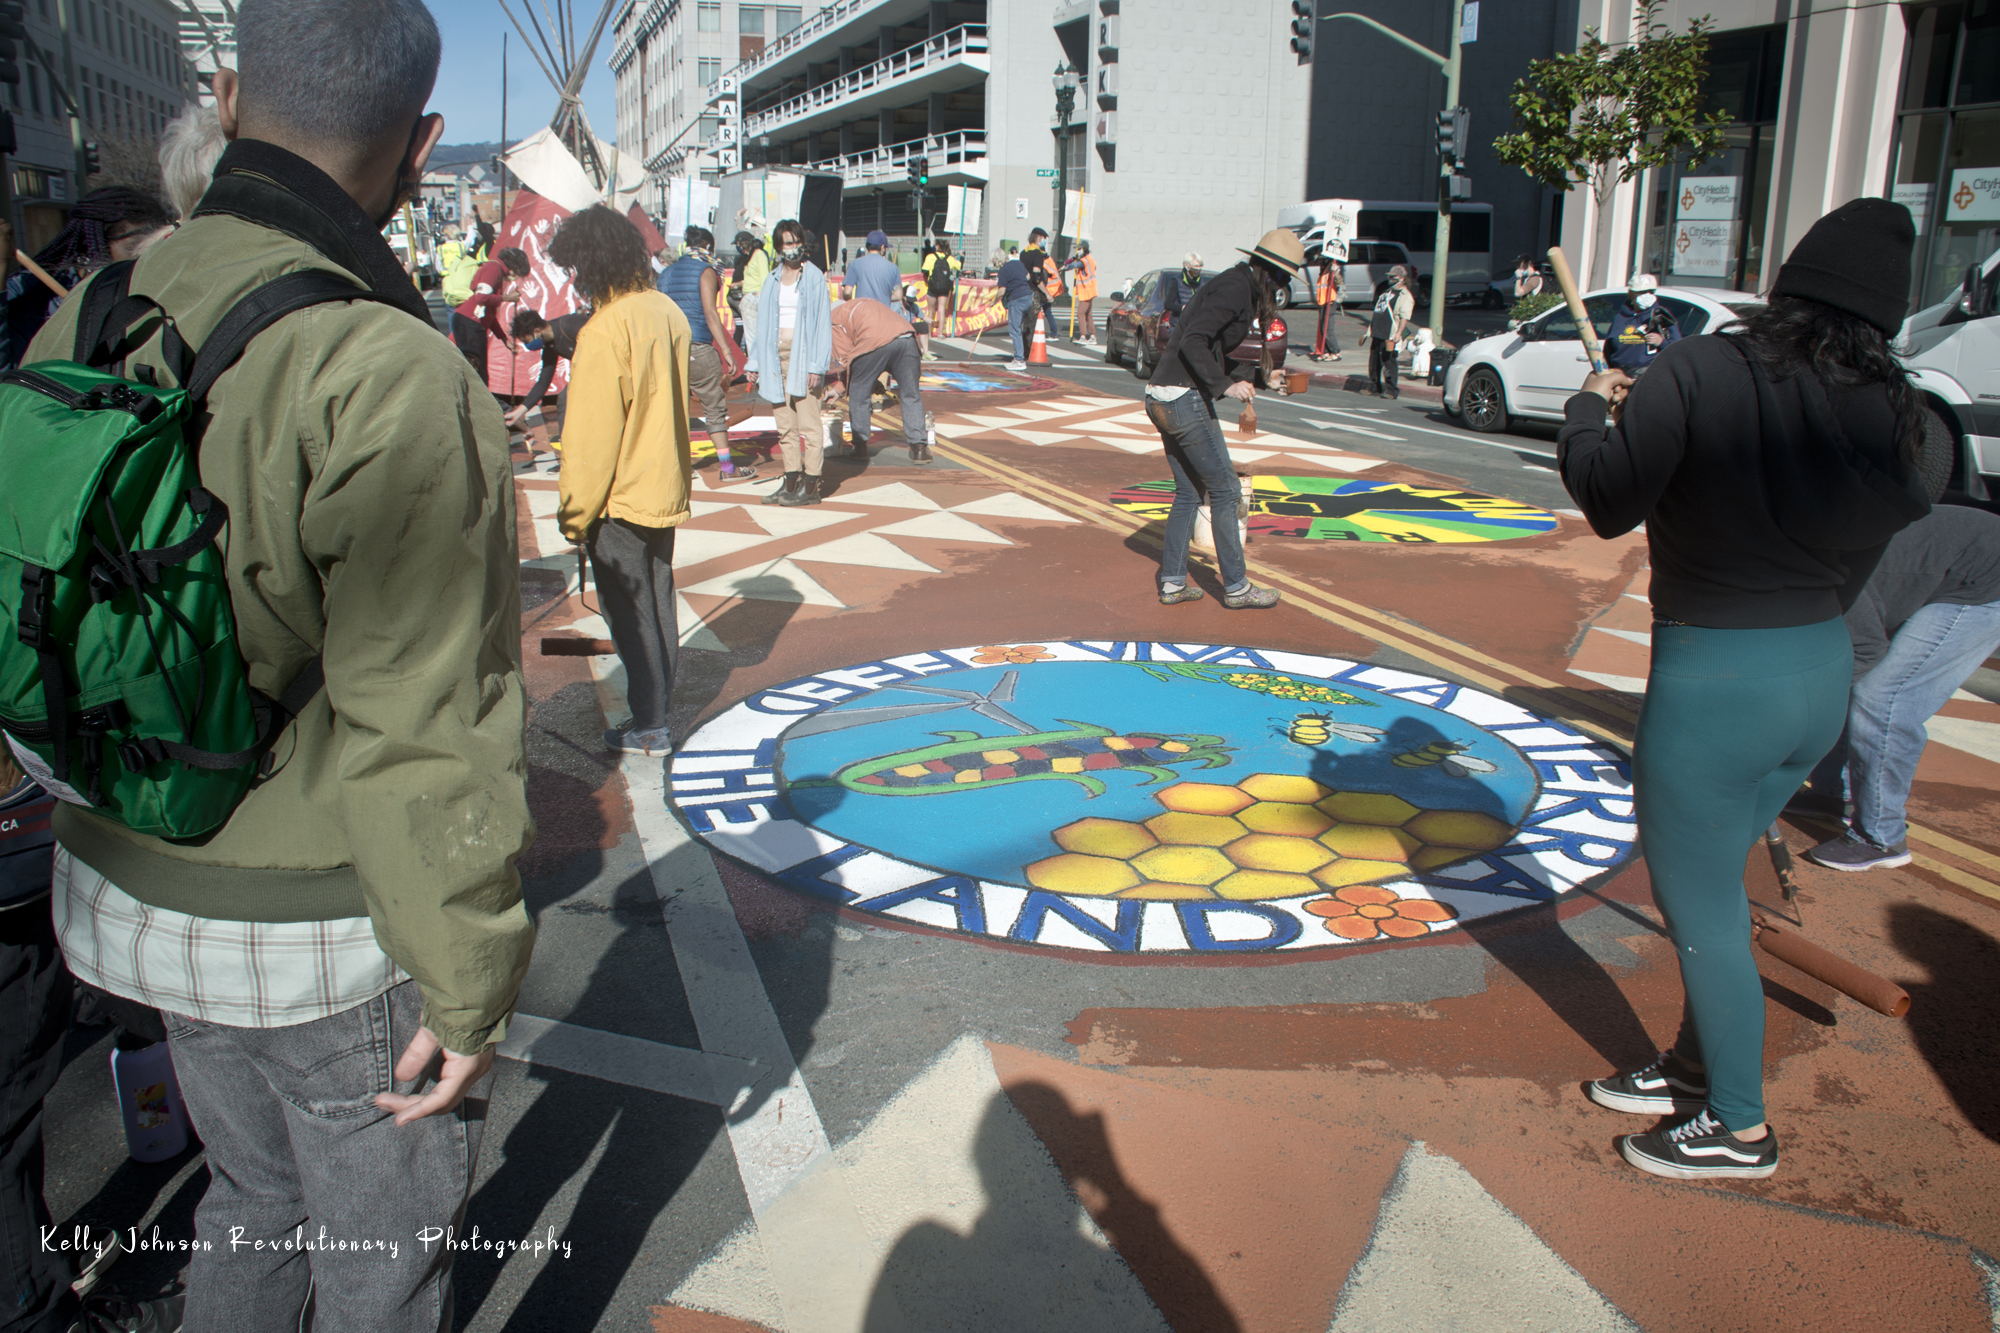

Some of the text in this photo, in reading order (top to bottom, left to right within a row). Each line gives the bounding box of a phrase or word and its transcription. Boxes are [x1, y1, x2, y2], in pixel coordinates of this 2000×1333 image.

[722, 78, 732, 165] PARK
[1693, 185, 1730, 197] CityHealth
[1705, 195, 1738, 204] UrgentCare
[1688, 226, 1728, 238] CityHealth
[1701, 237, 1736, 247] UrgentCare
[1687, 258, 1701, 266] NOW
[1064, 640, 1637, 901] VIVA LA TIERRA
[670, 650, 1304, 952] FEED THE LAND
[0, 818, 19, 832] CA
